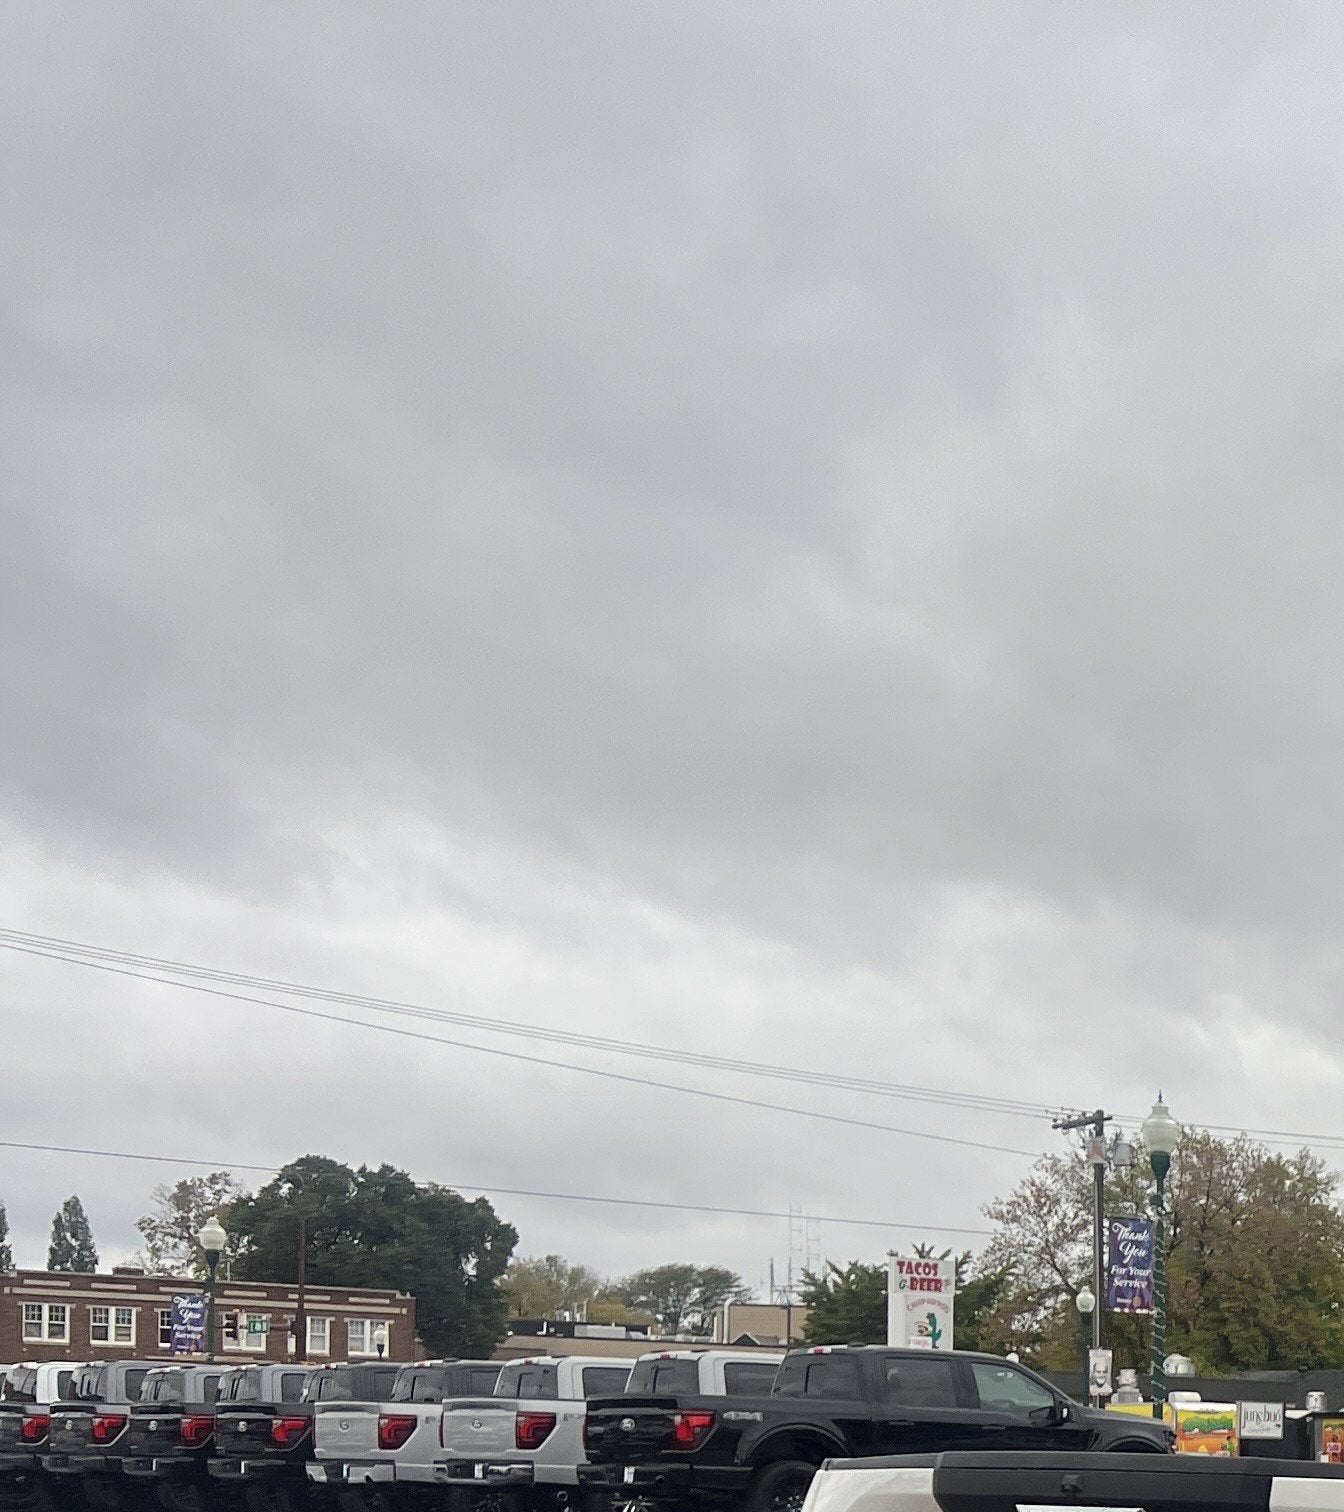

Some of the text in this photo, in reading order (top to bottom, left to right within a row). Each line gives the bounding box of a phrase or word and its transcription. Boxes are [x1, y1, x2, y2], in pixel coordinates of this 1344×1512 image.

[1112, 1222, 1149, 1241] Thank
[1119, 1241, 1147, 1264] You
[896, 1261, 938, 1276] TACOS
[1111, 1265, 1151, 1277] For Your
[910, 1277, 943, 1292] BEER
[1113, 1277, 1148, 1289] Service
